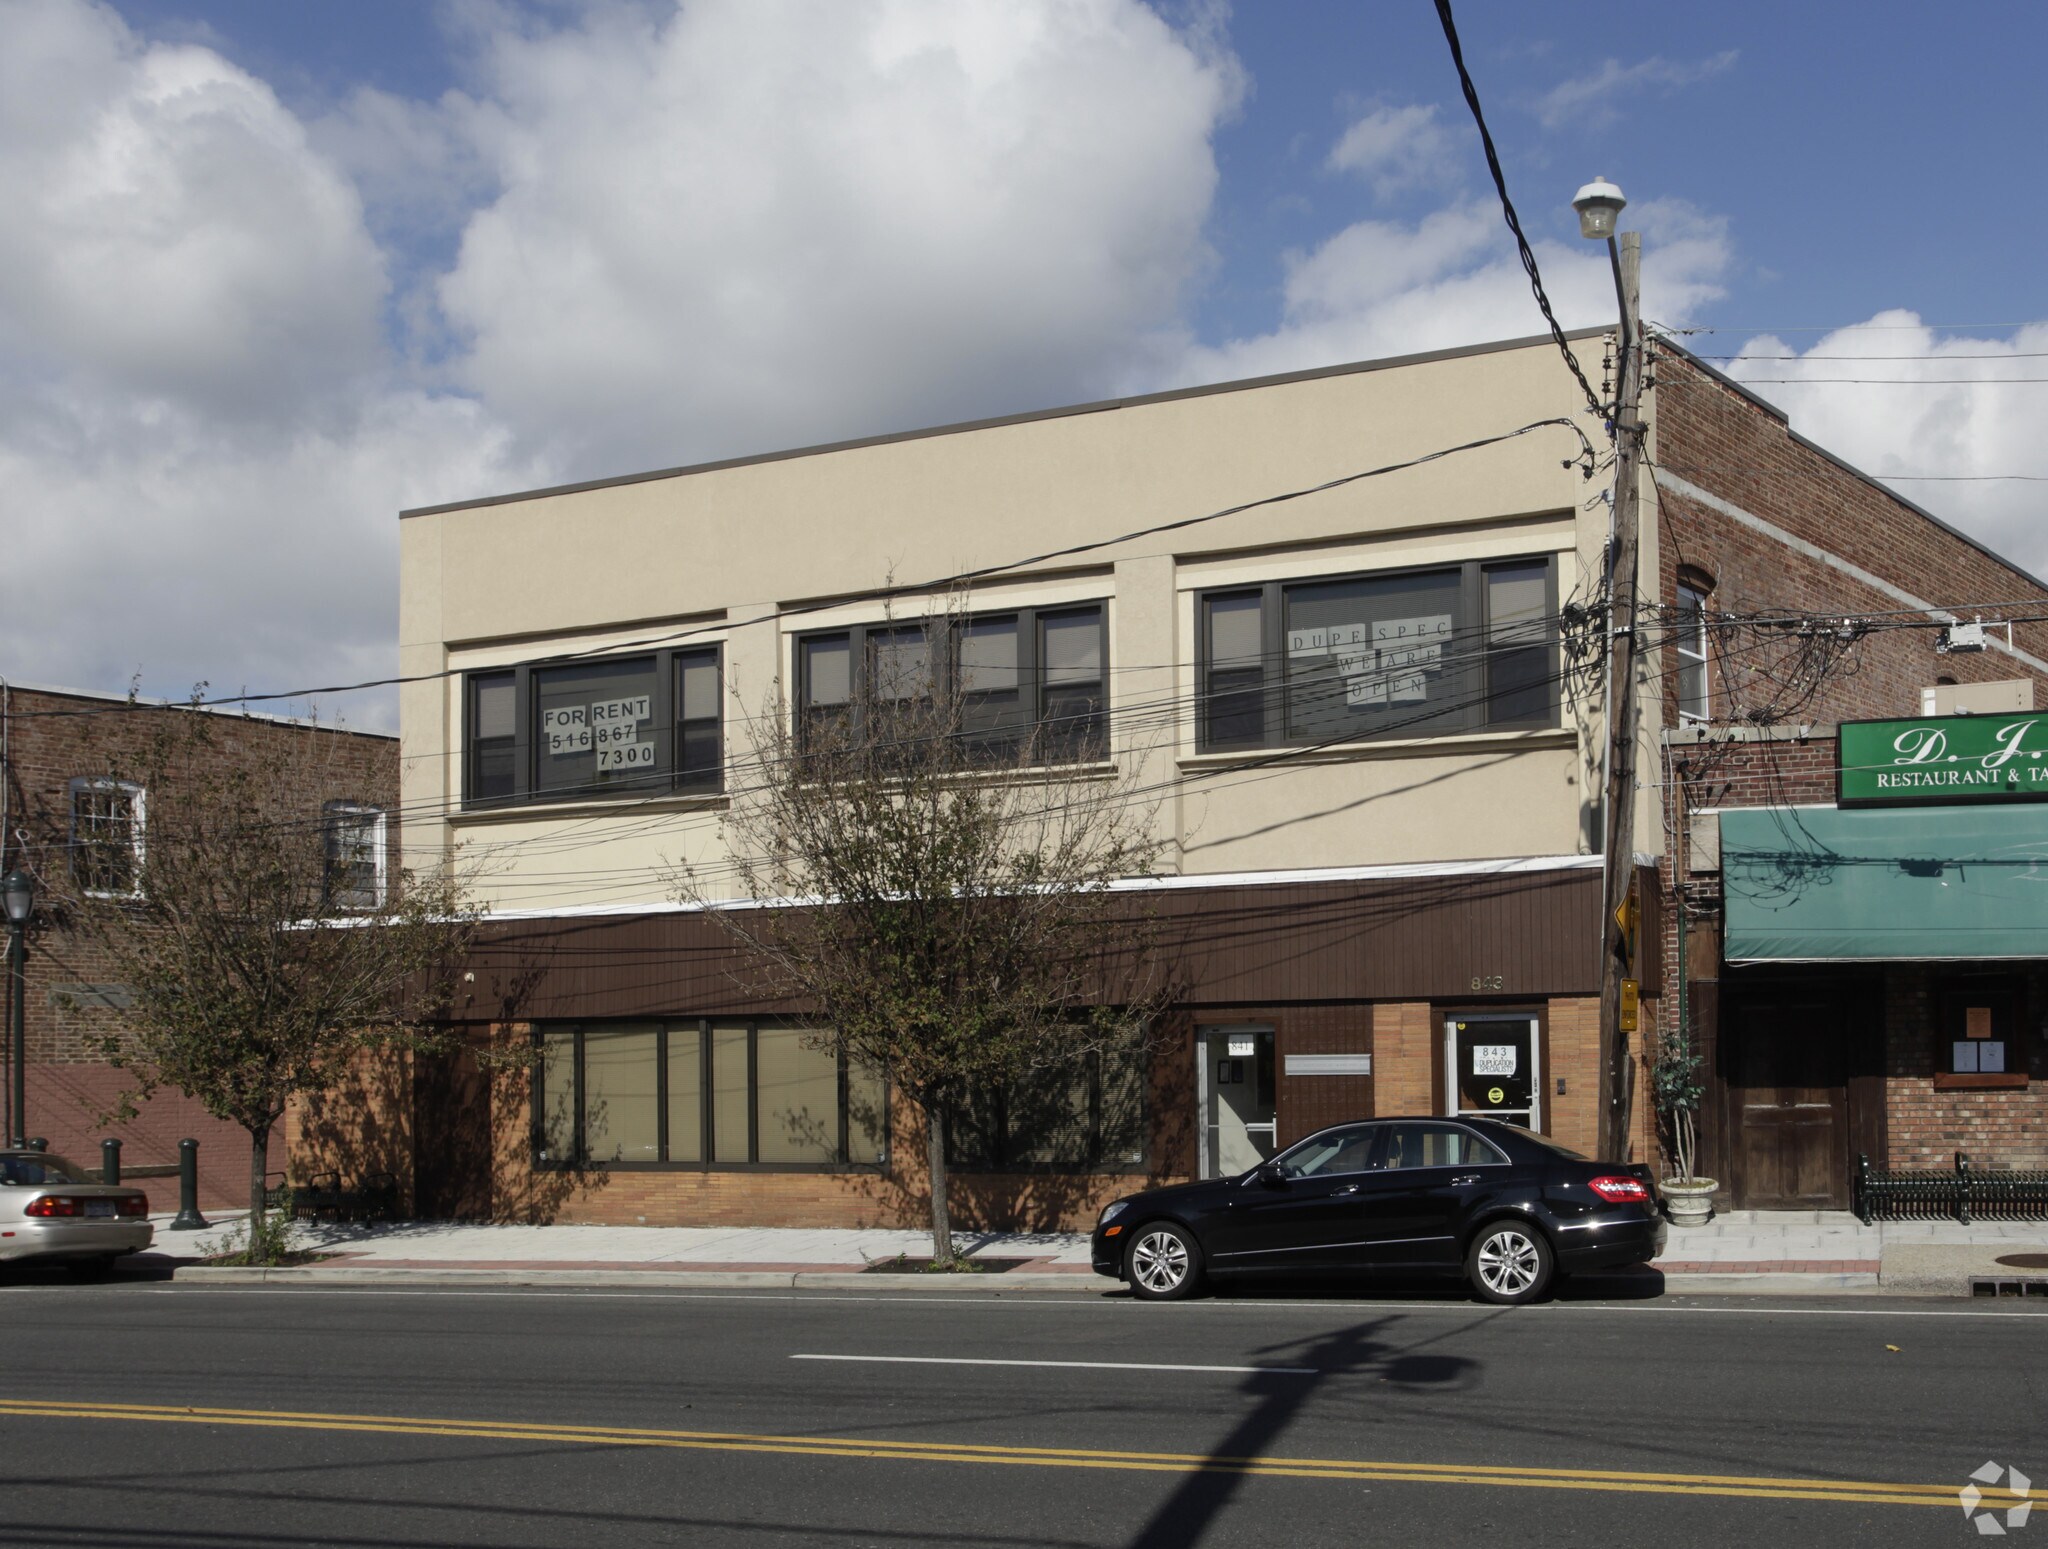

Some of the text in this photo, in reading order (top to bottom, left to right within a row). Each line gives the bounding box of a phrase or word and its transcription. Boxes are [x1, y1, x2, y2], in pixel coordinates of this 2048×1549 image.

[1293, 621, 1447, 650] DUPE SPEC
[1339, 650, 1436, 671] WE ARE
[1352, 678, 1422, 697] OPEN
[545, 700, 647, 726] FOR RENT
[552, 724, 634, 749] 516 867
[1893, 719, 2042, 769] D. J.
[599, 747, 652, 766] 7300
[1877, 769, 2001, 787] RESTAURANT
[2007, 767, 2021, 783] &
[1482, 1047, 1507, 1057] 843
